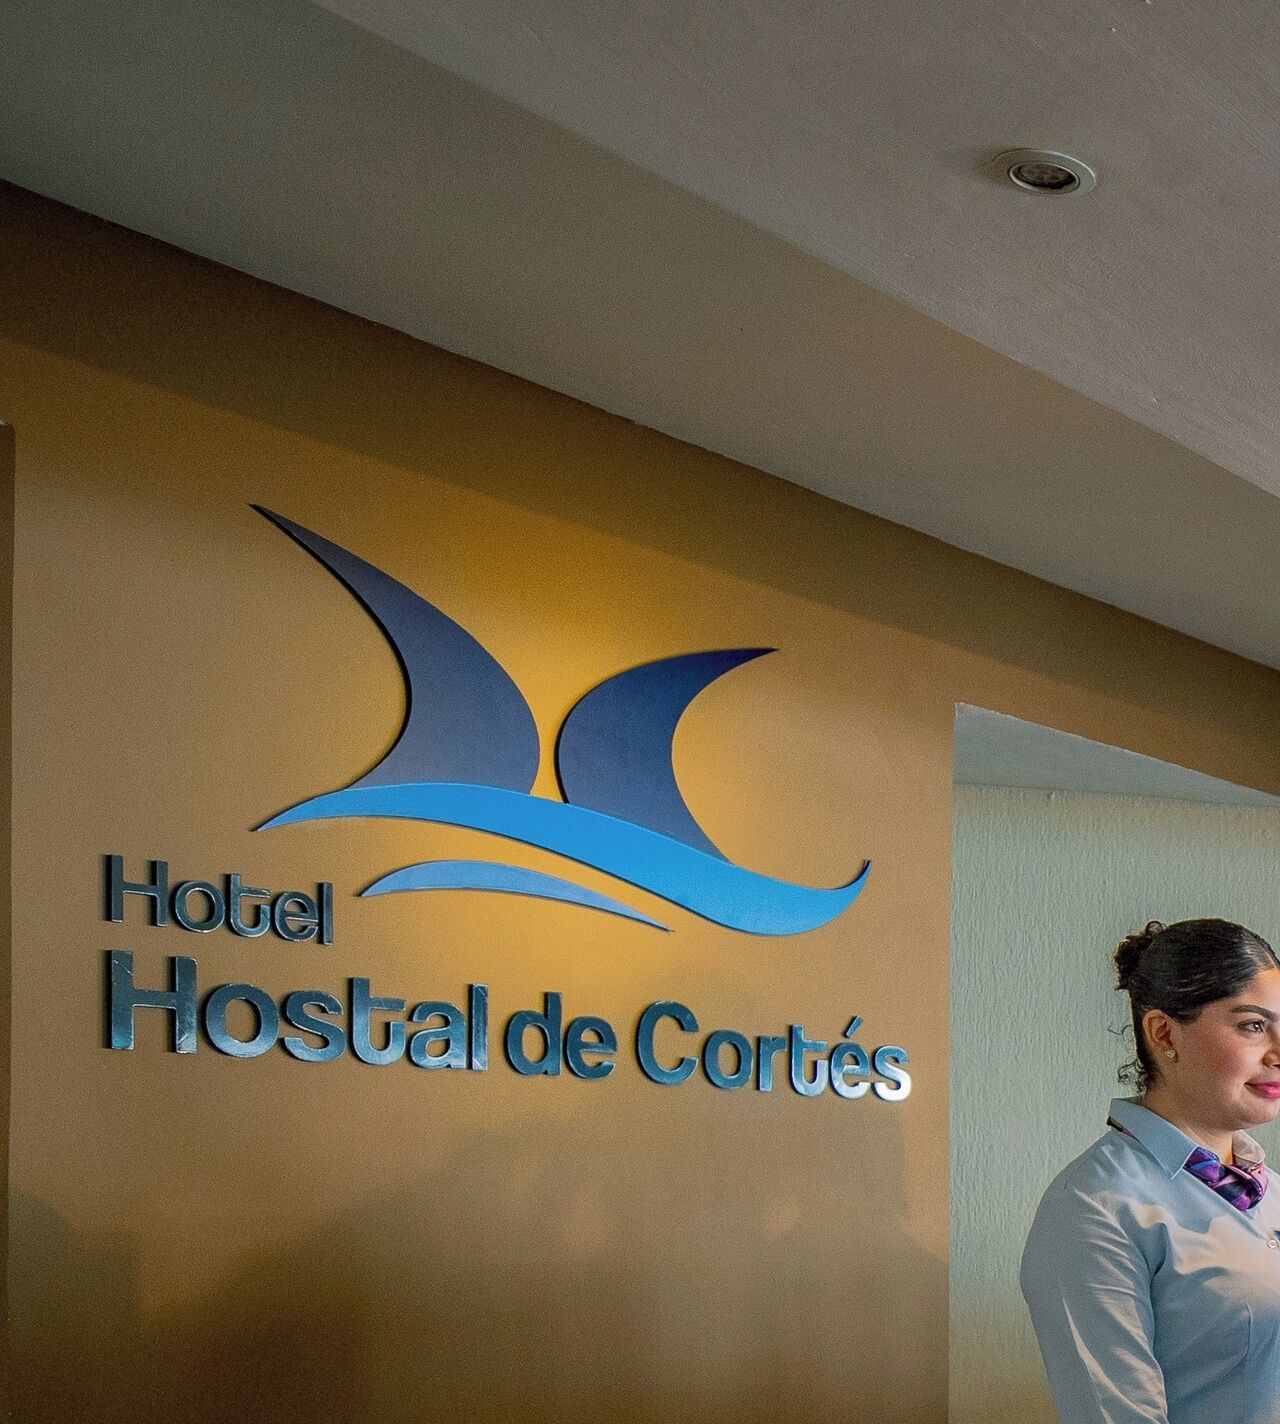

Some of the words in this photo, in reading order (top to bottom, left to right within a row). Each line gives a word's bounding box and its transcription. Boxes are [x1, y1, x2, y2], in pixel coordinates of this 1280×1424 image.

[104, 853, 335, 946] Hotel
[105, 949, 490, 1072] Hostal
[506, 990, 618, 1080] de
[636, 1000, 913, 1103] Cortés
